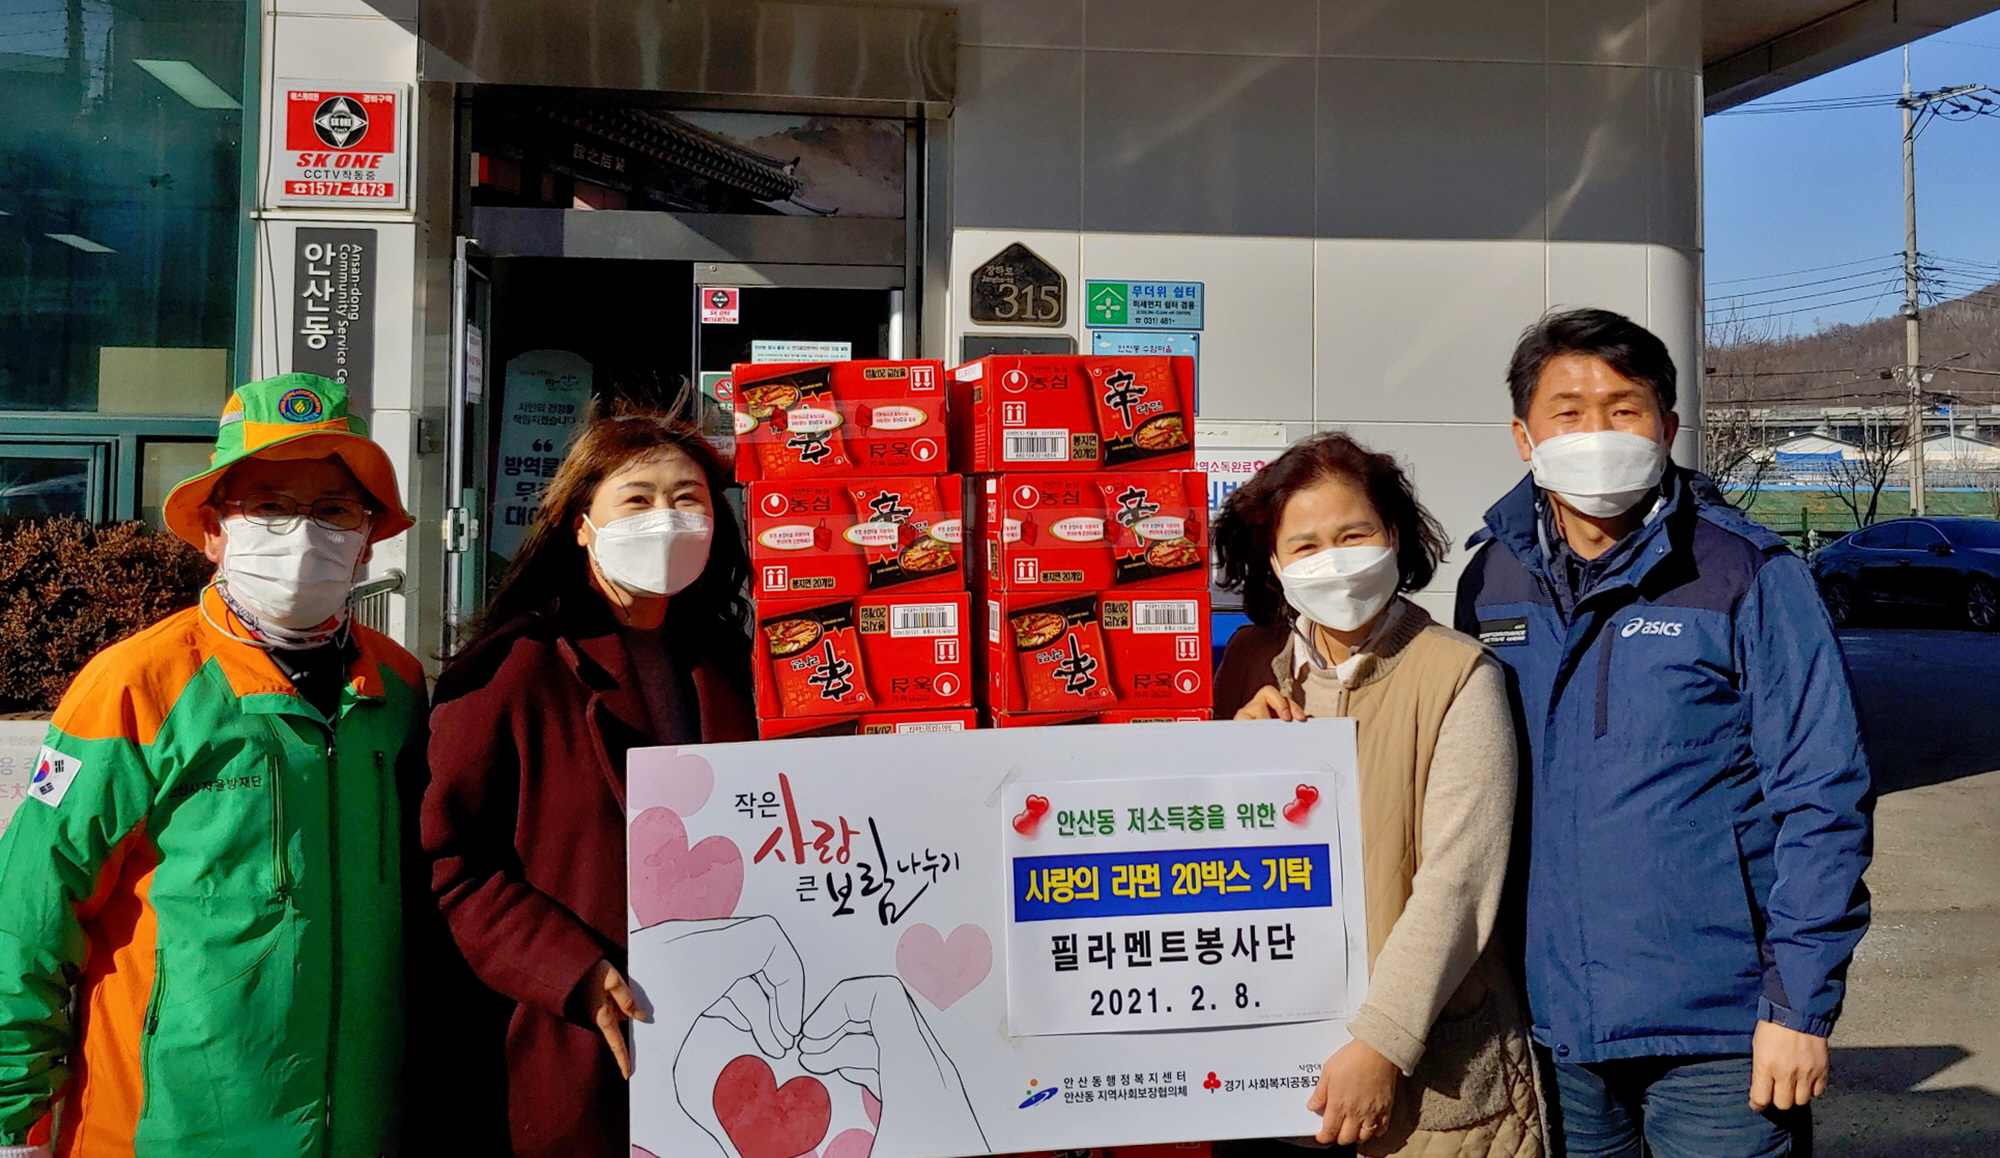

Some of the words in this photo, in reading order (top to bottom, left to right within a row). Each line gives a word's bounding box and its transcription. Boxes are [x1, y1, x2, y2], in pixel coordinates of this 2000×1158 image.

[363, 95, 393, 103] 경비구역
[331, 118, 339, 126] SK
[340, 118, 352, 126] ONE
[297, 153, 331, 167] SK
[335, 154, 383, 168] ONE
[308, 183, 385, 196] 1577-4473
[987, 265, 1014, 276] 장하로
[336, 244, 350, 316] Community
[348, 244, 363, 320] Ansan-dong
[300, 243, 336, 349] 안산동
[1132, 286, 1166, 297] 무더위
[1174, 286, 1195, 298] 쉼터
[995, 284, 1059, 319] 315
[1133, 301, 1161, 309] 미세먼지
[1165, 301, 1178, 309] 쉼터
[1181, 301, 1194, 309] 겸용
[337, 321, 349, 364] Service
[1118, 345, 1139, 353] 안산동
[865, 369, 886, 378] 20개입
[887, 368, 906, 378] 봉지면
[1030, 375, 1068, 390] 농심
[1105, 369, 1147, 429] 辛
[1137, 401, 1163, 414] 라면
[1072, 435, 1097, 446] 봉지면
[870, 442, 908, 459] 농심
[1072, 448, 1097, 460] 20개입
[505, 456, 565, 478] 방역물
[791, 497, 830, 512] 농심
[1041, 490, 1079, 505] 농심
[792, 579, 812, 588] 봉지면
[813, 578, 833, 587] 20개입
[1042, 572, 1061, 582] 봉지면
[1063, 572, 1083, 582] 20개입
[861, 607, 886, 619] 20개입
[1105, 603, 1129, 614] 20개입
[861, 621, 886, 631] 봉지면
[1105, 616, 1129, 626] 봉지면
[1641, 621, 1683, 636] asics
[791, 655, 819, 670] 라면
[1036, 649, 1064, 664] 라면
[808, 639, 853, 701] 辛
[1053, 633, 1097, 696] 辛
[891, 676, 931, 693] 농심
[1134, 672, 1172, 689] 농심
[735, 791, 780, 818] 작은
[754, 773, 860, 865] 사랑
[1056, 809, 1115, 836] 안산동
[1127, 804, 1225, 833] 저소득층을
[1237, 802, 1277, 829] 위한
[796, 875, 819, 902] 큰
[826, 817, 929, 926] 보람
[898, 848, 959, 883] 나누기
[1025, 866, 1100, 903] 사랑의
[1111, 863, 1161, 899] 라면
[1172, 860, 1251, 896] 20박스
[1261, 857, 1313, 892] 기탁
[1051, 923, 1296, 972] 필라멘트봉사단
[1090, 988, 1173, 1016] 2021.
[1191, 985, 1216, 1011] 2.
[1235, 983, 1261, 1009] 8.
[1225, 1080, 1244, 1092] 경기
[1064, 1091, 1094, 1104] 안산동
[1098, 1085, 1188, 1101] 지역사회보장협의체
